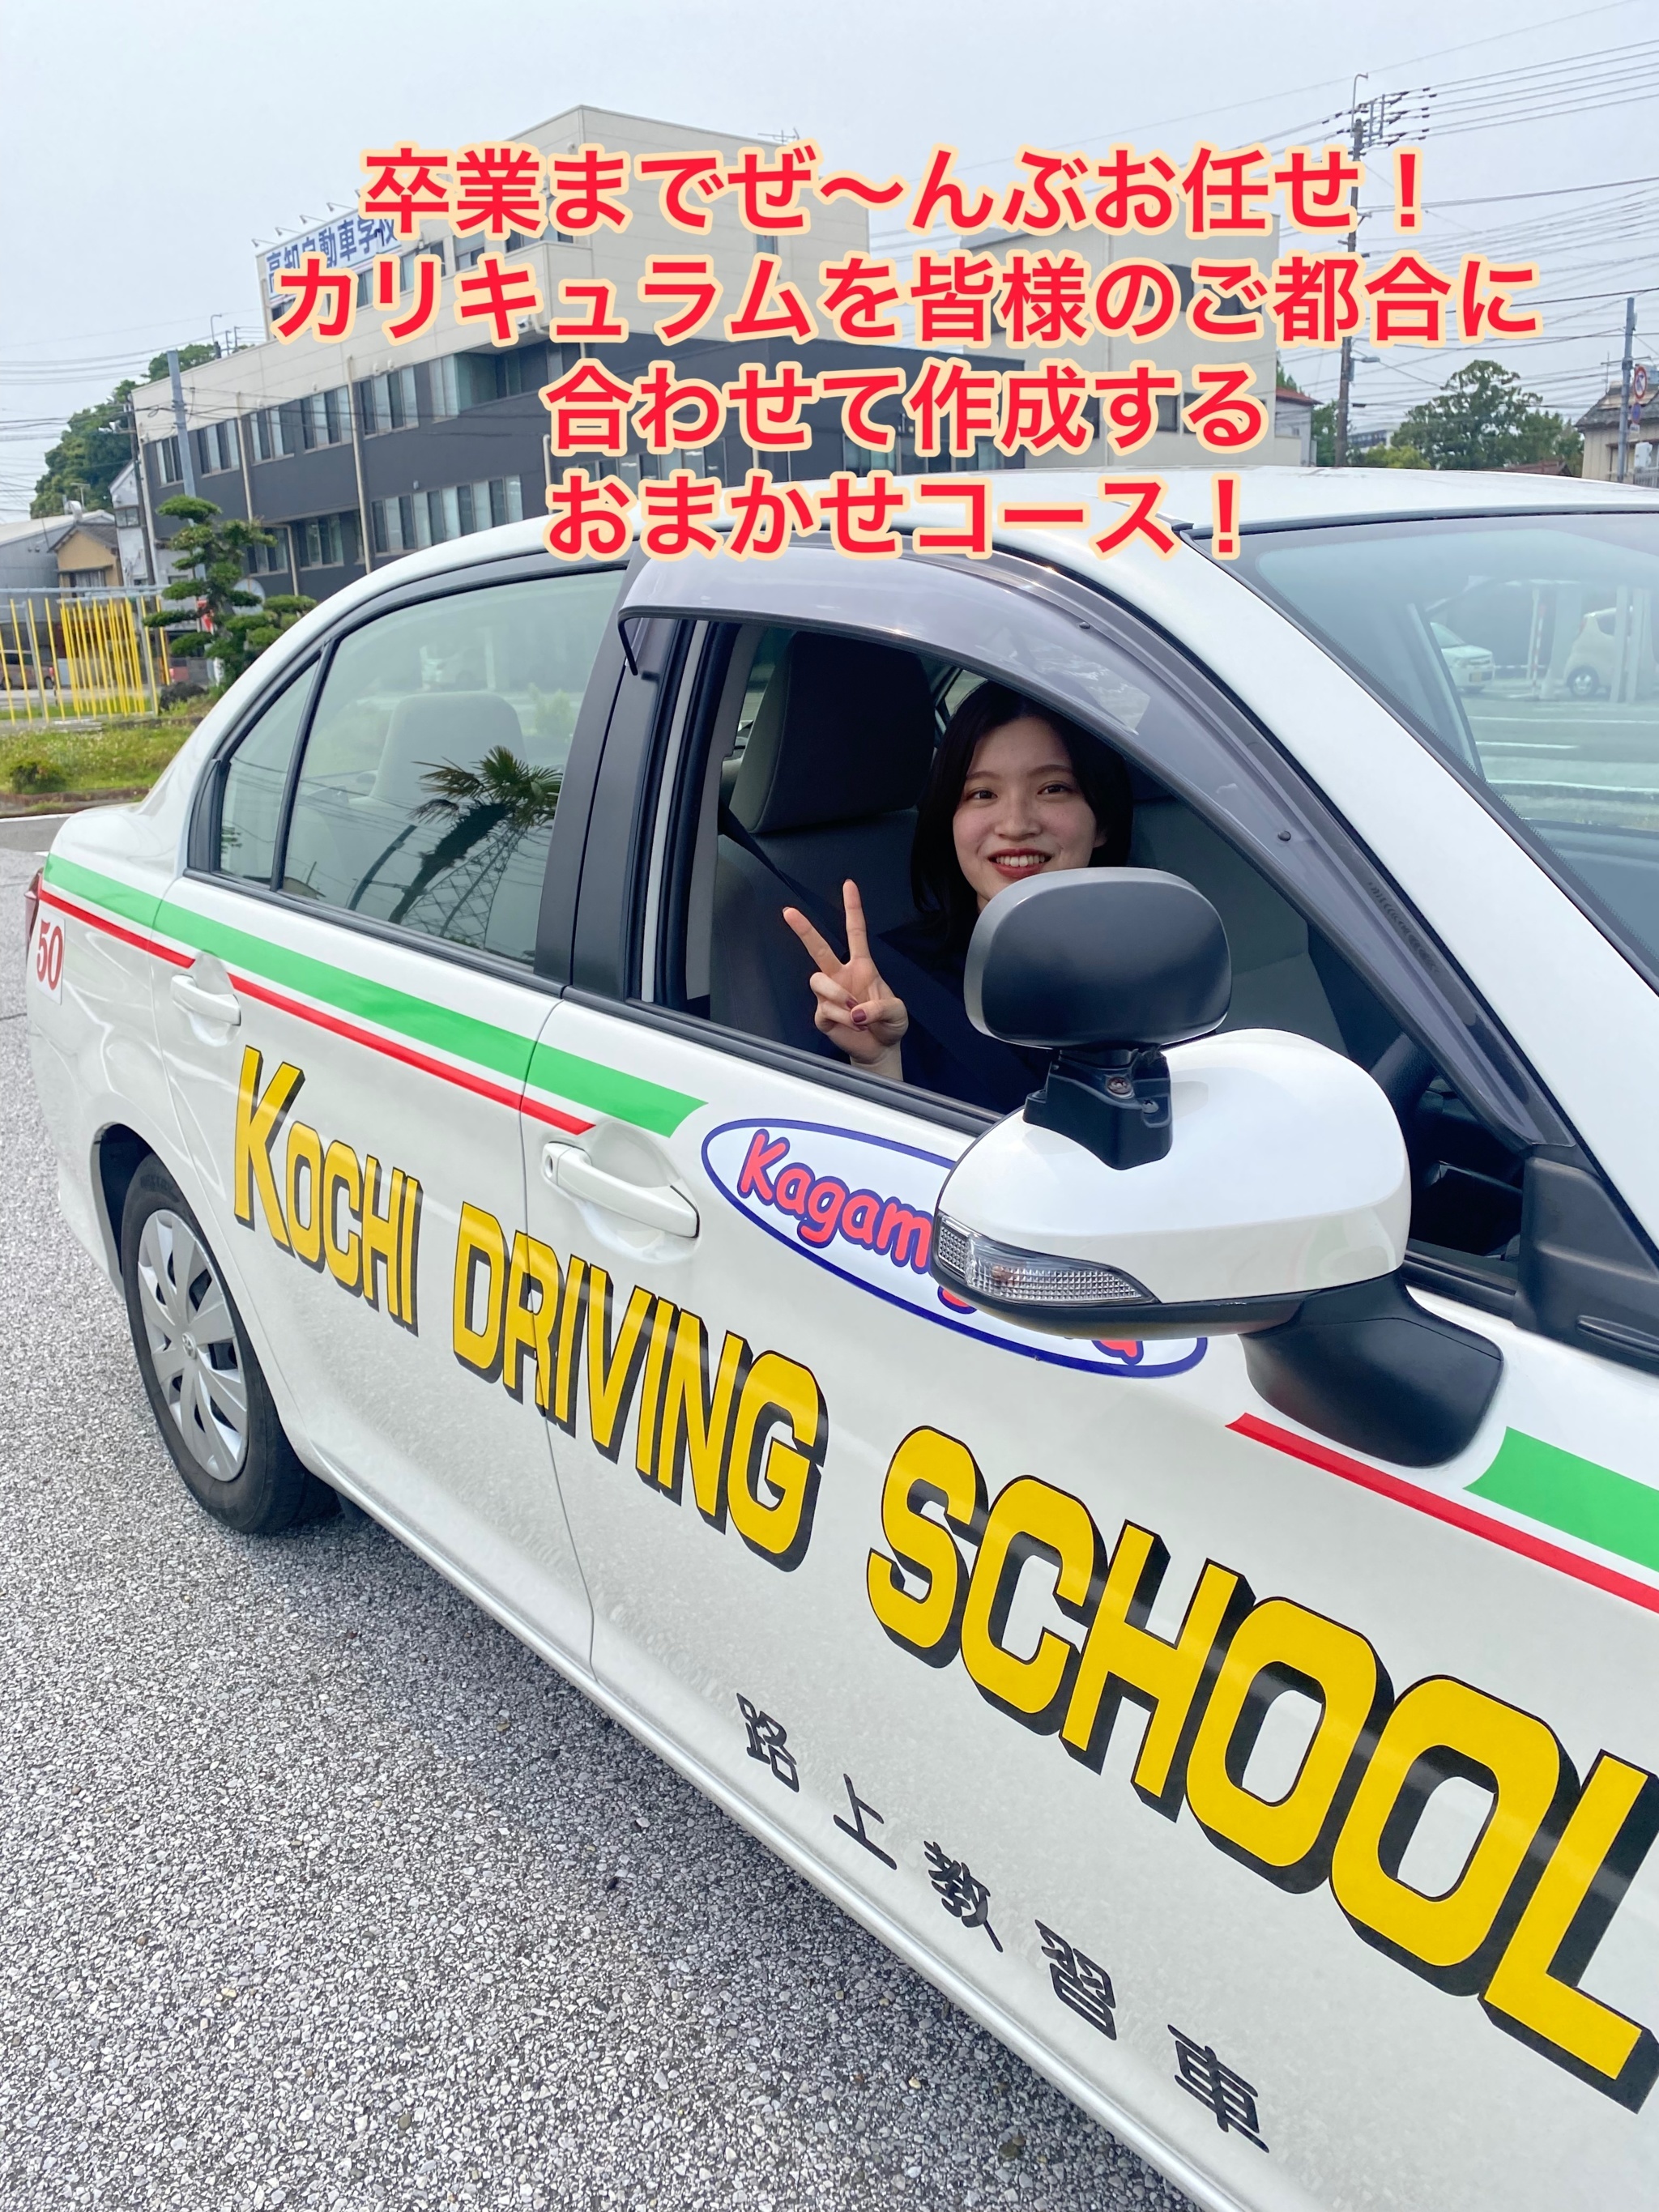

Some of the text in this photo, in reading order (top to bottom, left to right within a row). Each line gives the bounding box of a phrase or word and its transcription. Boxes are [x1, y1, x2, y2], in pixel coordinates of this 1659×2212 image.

[36, 921, 63, 991] 50
[452, 1201, 829, 1573] DRIVING
[866, 1426, 1659, 2114] SCHOOL
[736, 1692, 1269, 2153] 路上教習車
